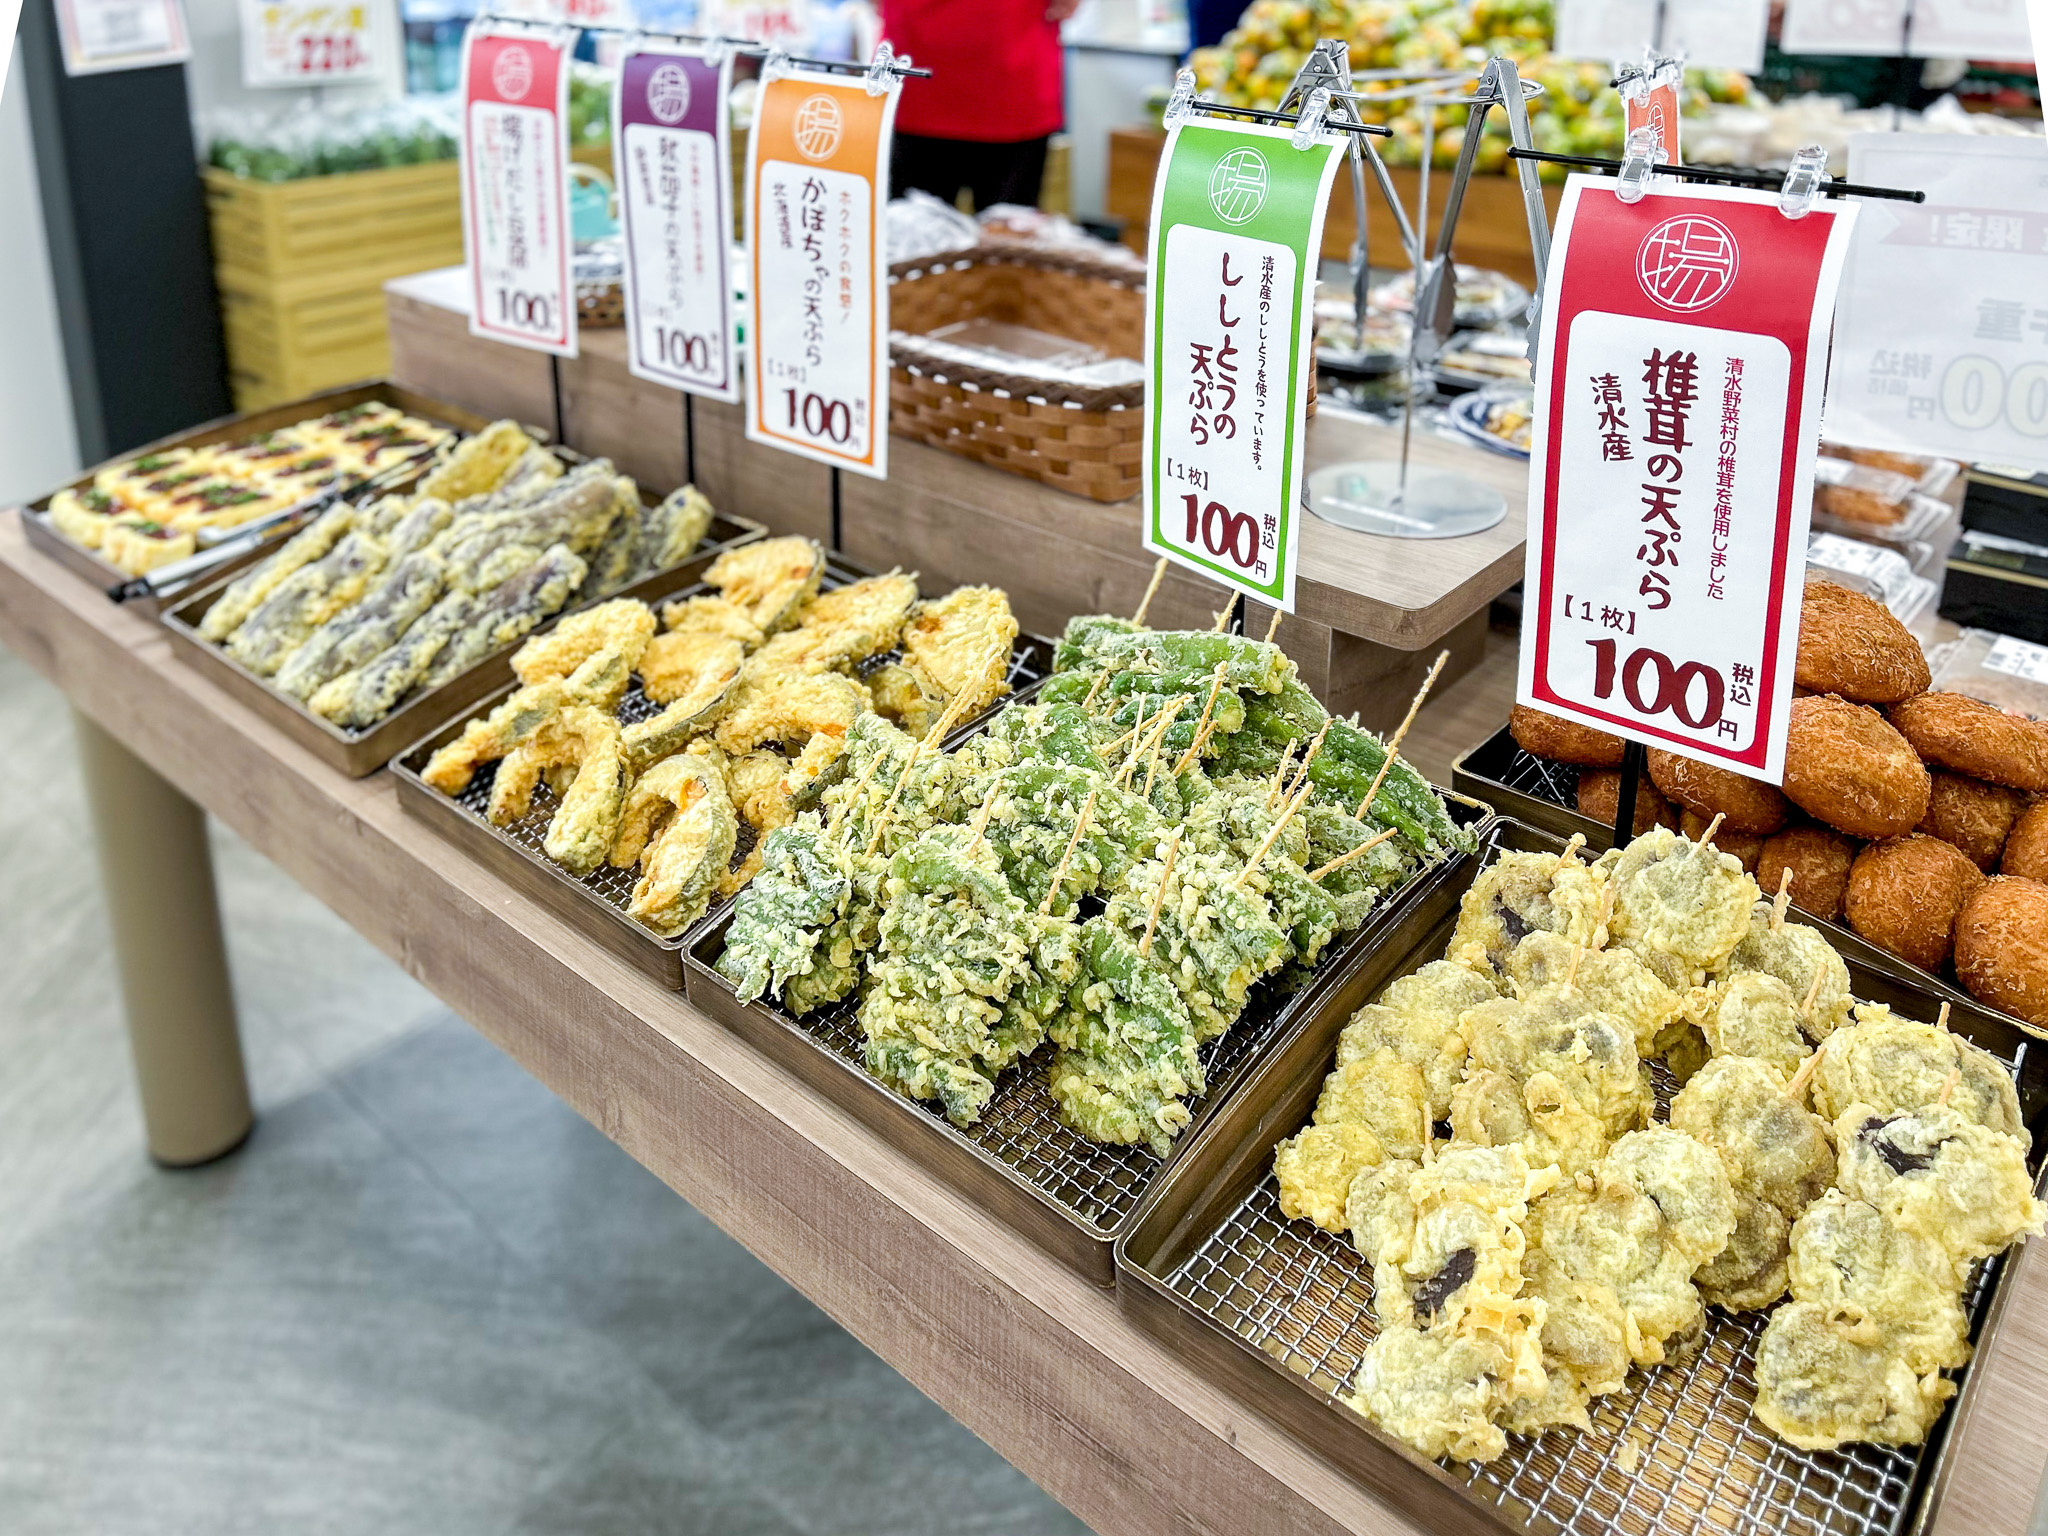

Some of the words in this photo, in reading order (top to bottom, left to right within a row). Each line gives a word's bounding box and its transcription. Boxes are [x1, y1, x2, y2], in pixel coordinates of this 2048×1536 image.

[498, 288, 550, 331] 100
[801, 176, 830, 368] かぼちゃの天ぷら
[654, 326, 708, 376] 100
[1252, 255, 1275, 472] 清水産のししとうを使っています。
[1589, 372, 1635, 462] 清水産
[1636, 347, 1700, 611] 椎茸の天ぷら
[1707, 356, 1745, 601] 清水野菜村の椎茸を使用しました
[1262, 513, 1276, 550] 税込
[1730, 662, 1754, 707] 税込
